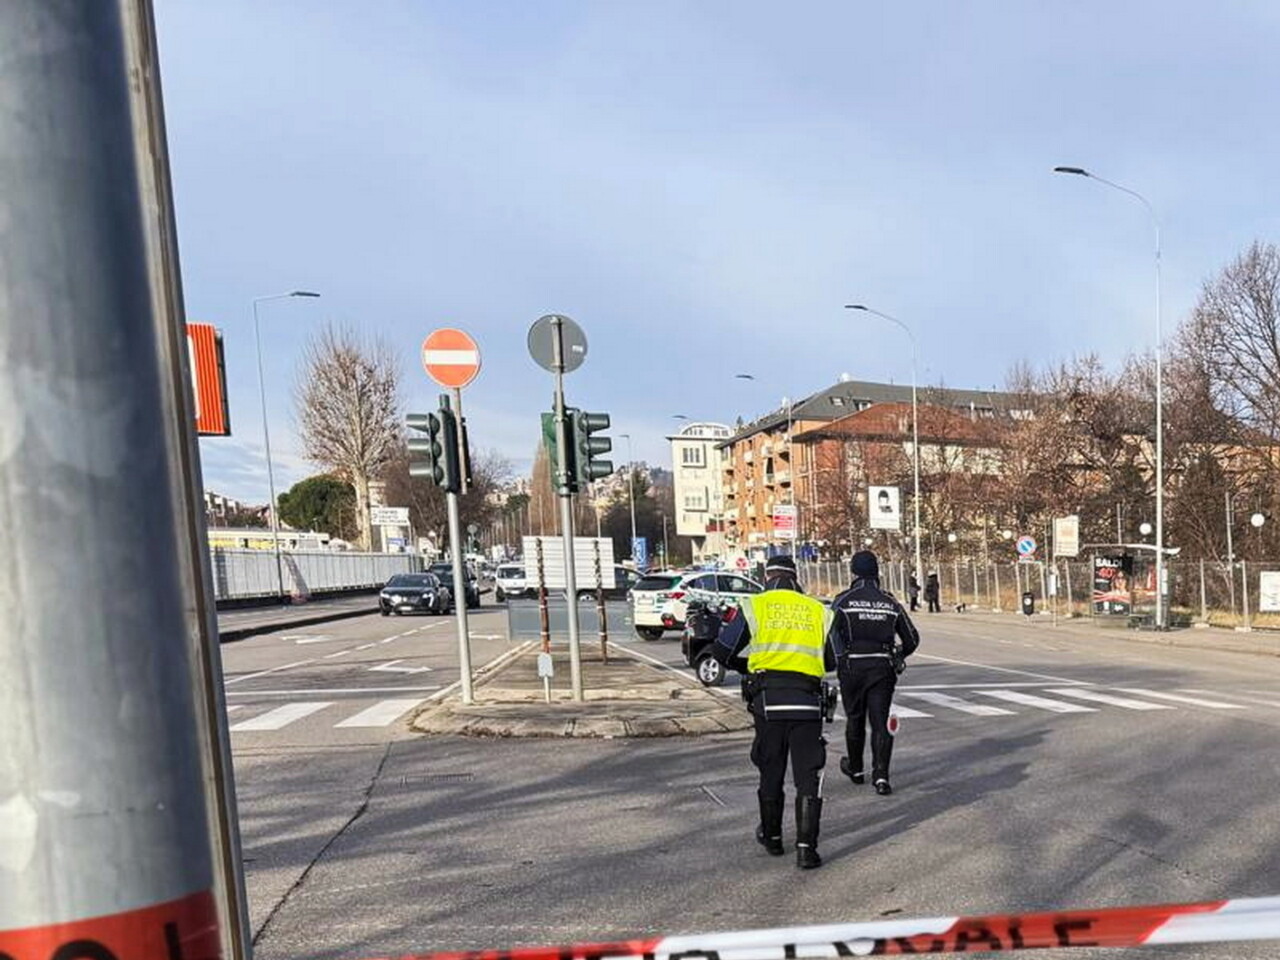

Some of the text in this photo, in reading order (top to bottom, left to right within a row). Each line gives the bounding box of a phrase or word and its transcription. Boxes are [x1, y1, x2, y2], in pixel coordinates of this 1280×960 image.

[766, 602, 812, 613] POLIZIA
[872, 601, 895, 610] LOCALE
[767, 611, 813, 623] LOCALE
[765, 620, 815, 632] BERGAMO
